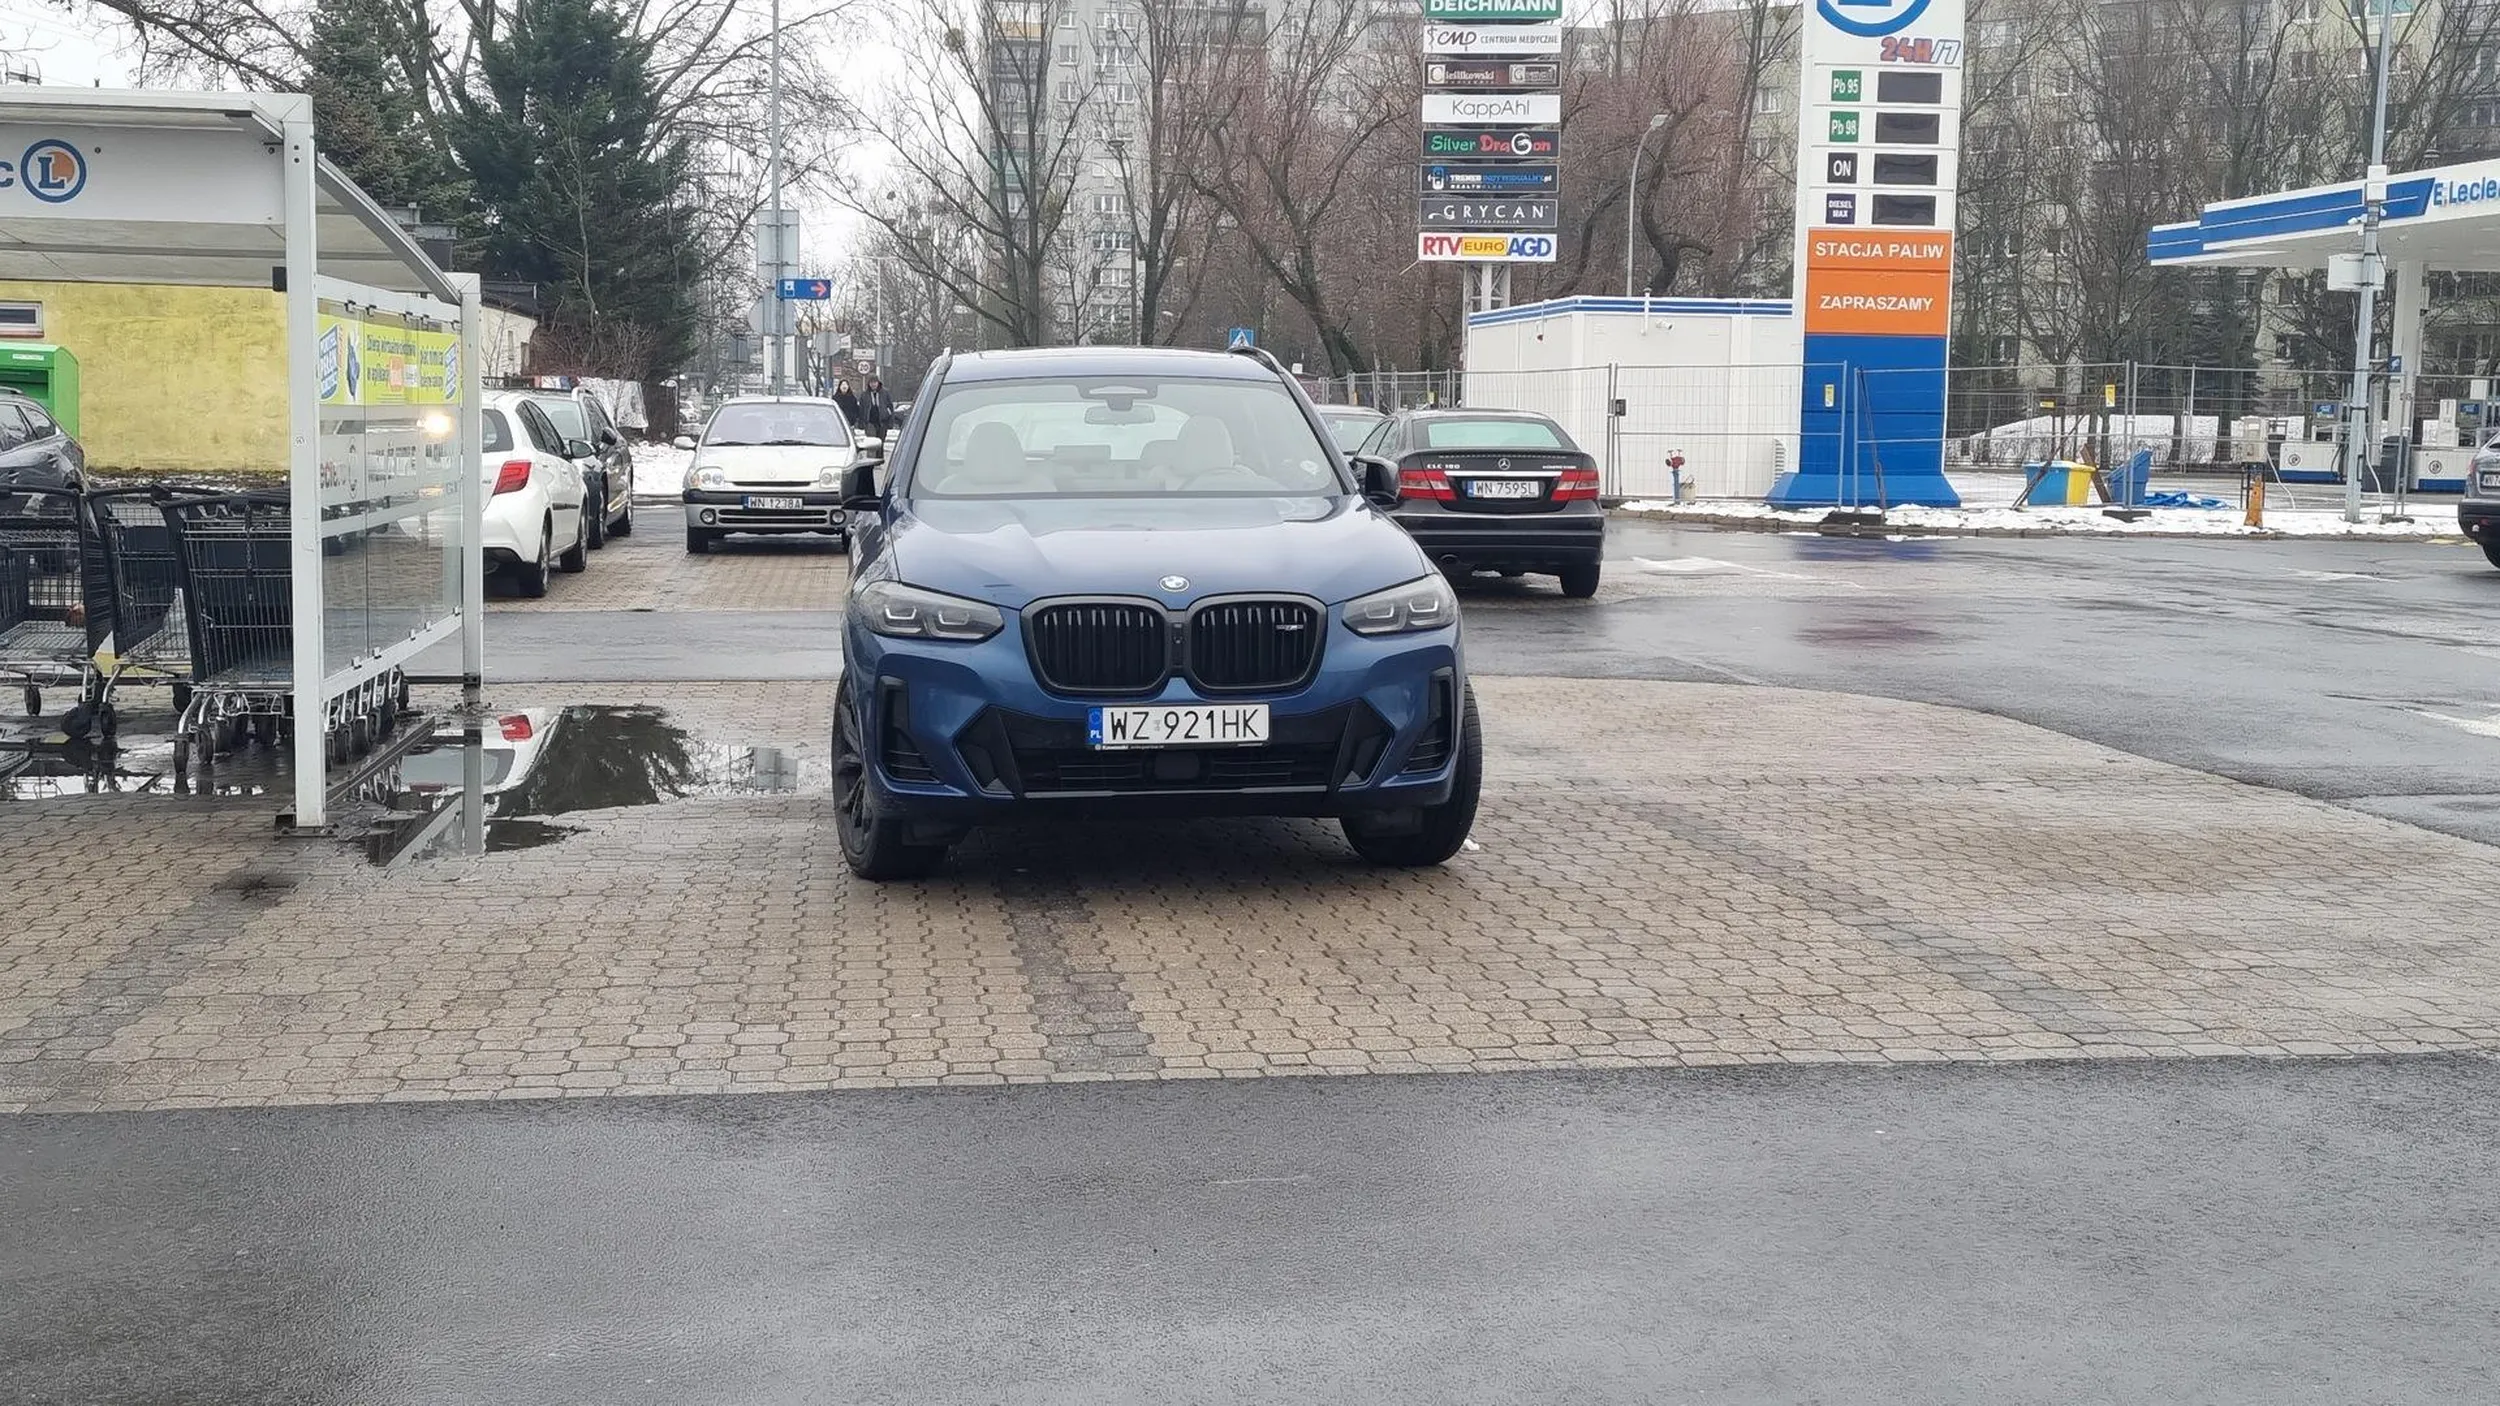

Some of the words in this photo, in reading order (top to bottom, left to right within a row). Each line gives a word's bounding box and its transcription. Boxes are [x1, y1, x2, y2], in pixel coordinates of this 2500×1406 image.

[1430, 0, 1557, 11] DEICHMANN
[1480, 35, 1517, 44] CENTRUM
[1833, 78, 1846, 93] Pb
[1847, 79, 1859, 94] 95
[1452, 100, 1530, 119] KappAhl
[1831, 119, 1844, 135] Pb
[1430, 134, 1476, 152] Silver
[1833, 160, 1851, 176] ON
[1443, 205, 1545, 220] GRYCAN
[1423, 236, 1463, 256] RTV
[1464, 241, 1505, 252] EURO
[1507, 237, 1552, 257] AGD
[1815, 242, 1883, 257] STACJA
[1888, 244, 1944, 258] PALIW
[1819, 295, 1934, 311] ZAPRASZAMY
[1110, 711, 1150, 740] WZ
[1163, 709, 1259, 739] 921HK
[1090, 730, 1101, 738] PL
